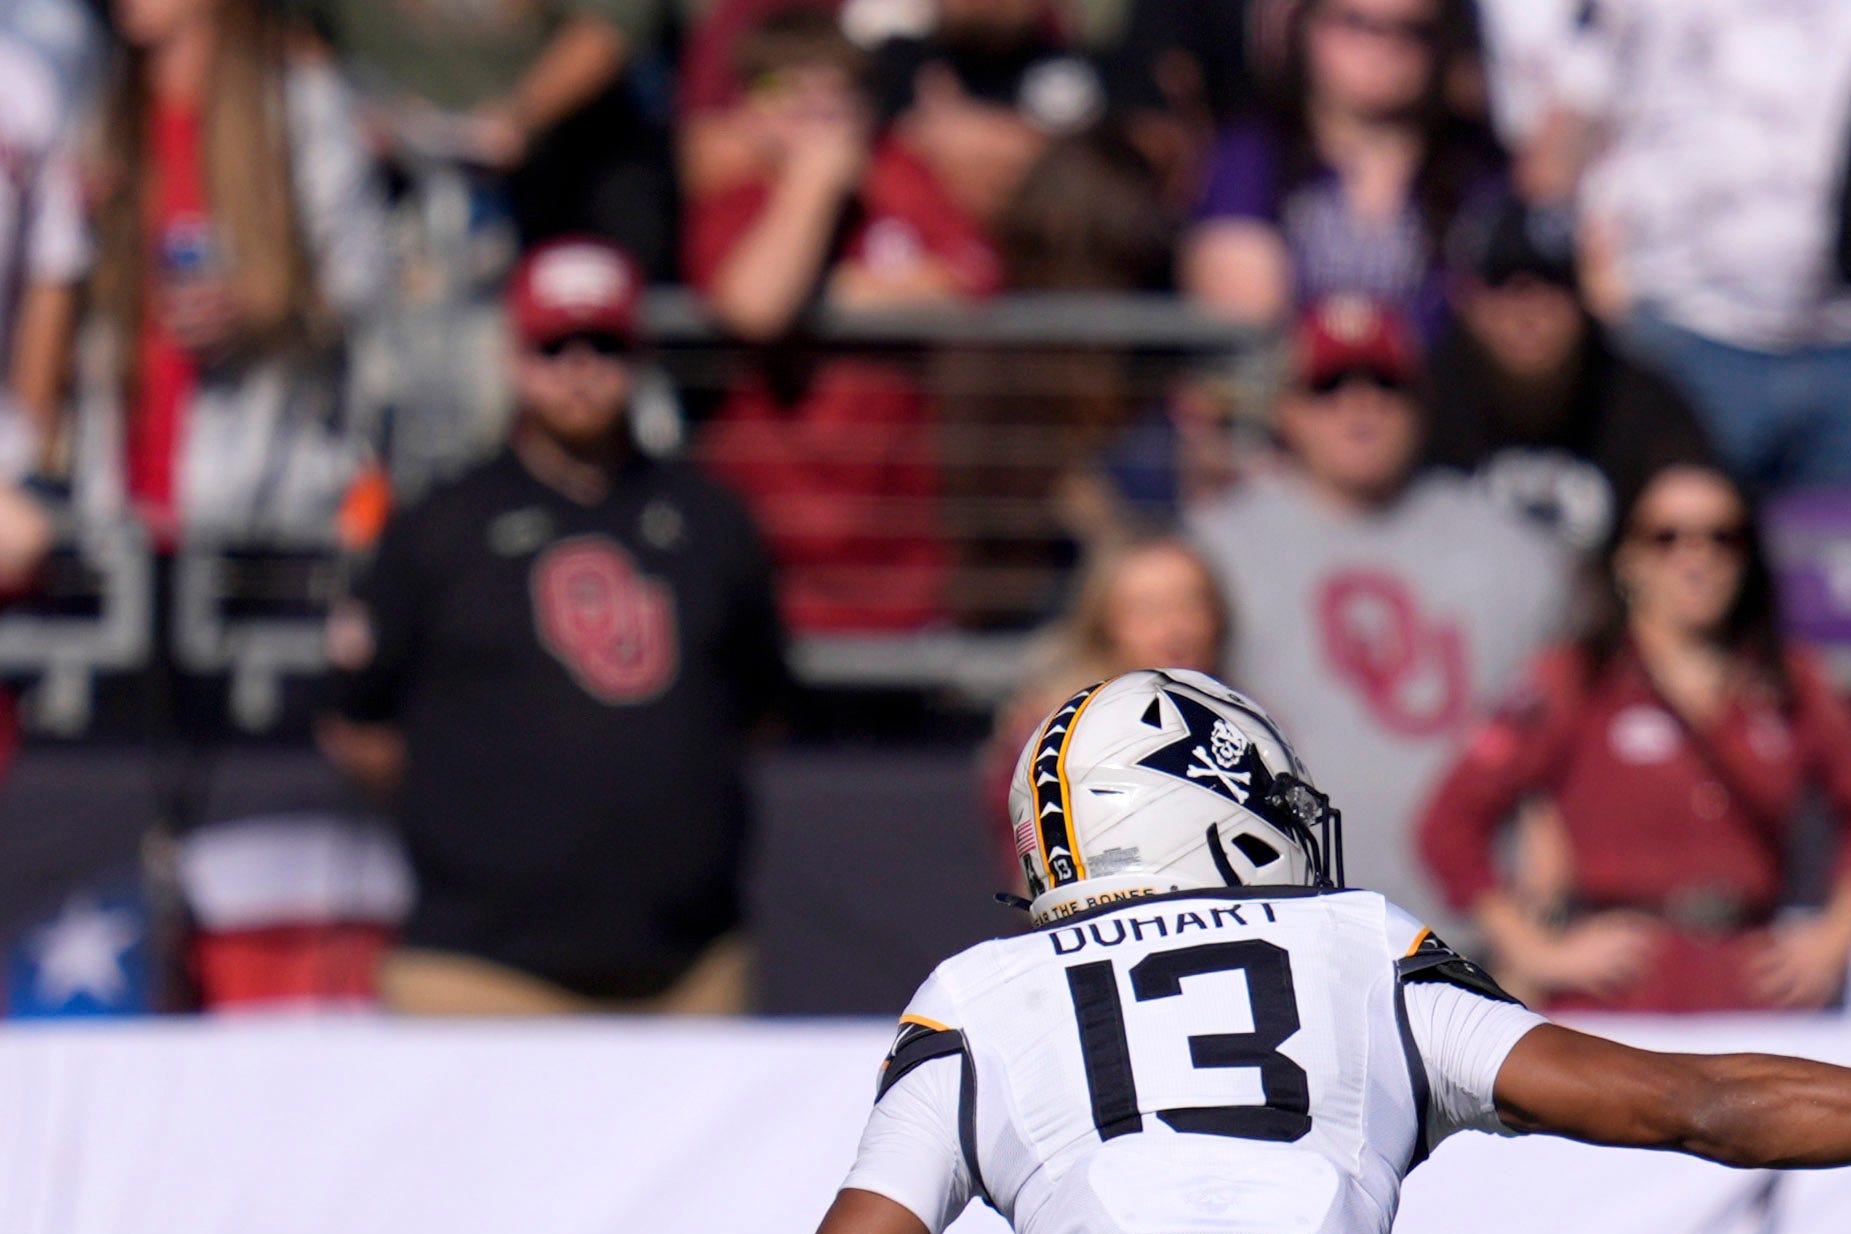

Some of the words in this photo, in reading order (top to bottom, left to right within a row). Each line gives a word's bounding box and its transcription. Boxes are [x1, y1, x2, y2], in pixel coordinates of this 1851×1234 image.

[528, 533, 681, 705] OU
[1312, 566, 1470, 737] OU
[1052, 901, 1081, 919] THE
[1053, 857, 1073, 882] 13
[1049, 902, 1277, 956] DUHART
[1065, 937, 1313, 1143] 13
